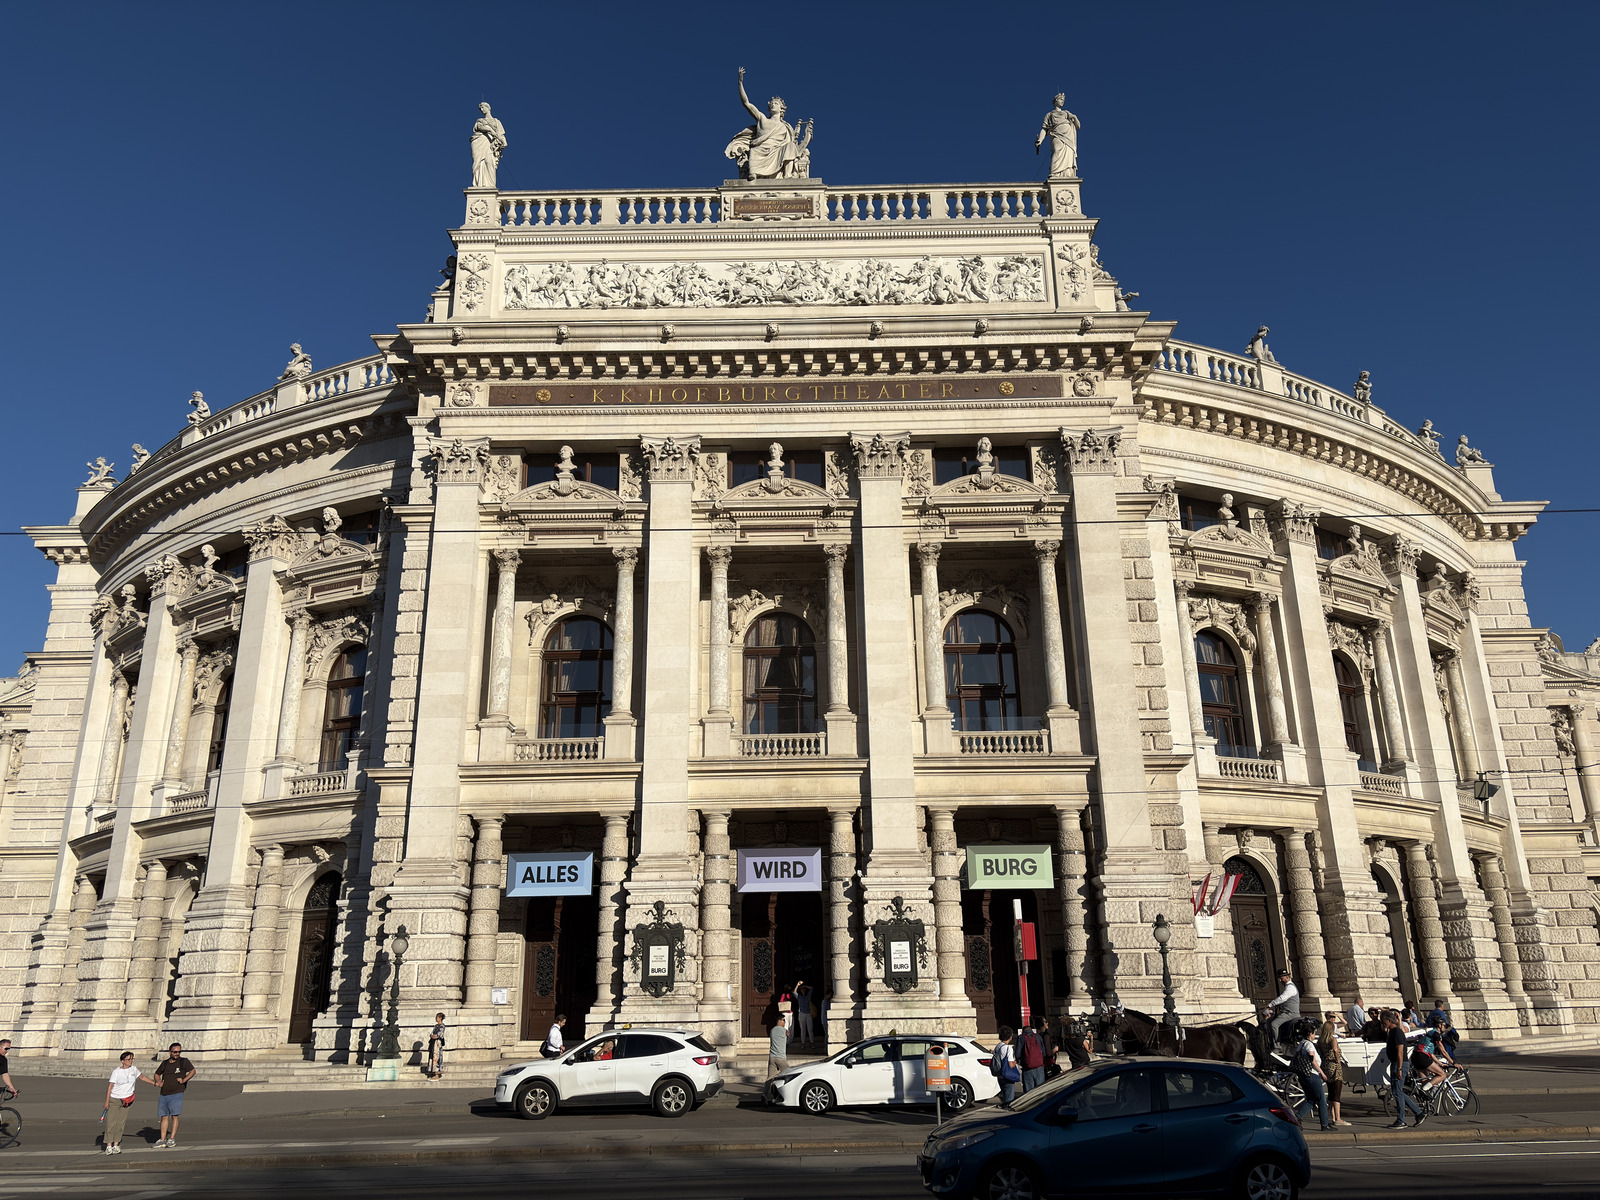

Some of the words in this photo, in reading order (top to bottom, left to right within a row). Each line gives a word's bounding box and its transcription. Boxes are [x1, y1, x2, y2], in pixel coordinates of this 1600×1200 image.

[521, 865, 579, 884] ALLES
[753, 860, 807, 879] WIRD
[983, 858, 1038, 876] BURG
